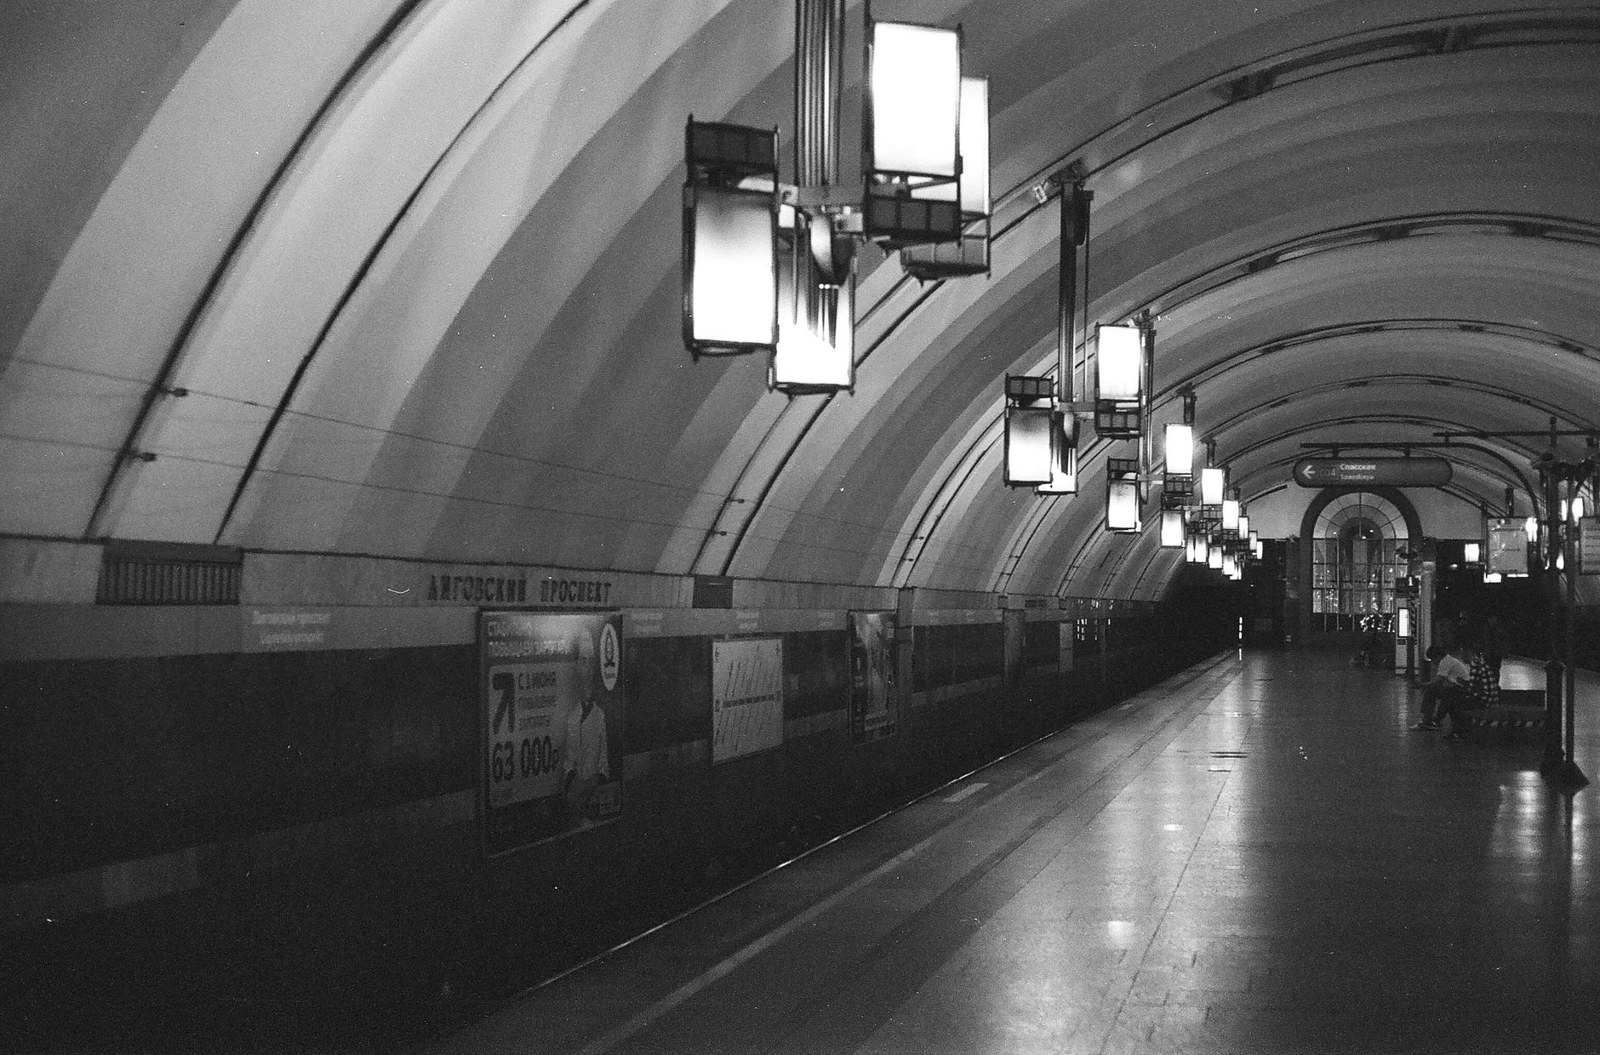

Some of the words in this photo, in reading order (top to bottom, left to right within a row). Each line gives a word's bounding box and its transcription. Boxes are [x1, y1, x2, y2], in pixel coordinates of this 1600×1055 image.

[1340, 463, 1376, 471] Спасская
[540, 579, 612, 603] ПРОСПЕКТ
[492, 740, 515, 783] 63
